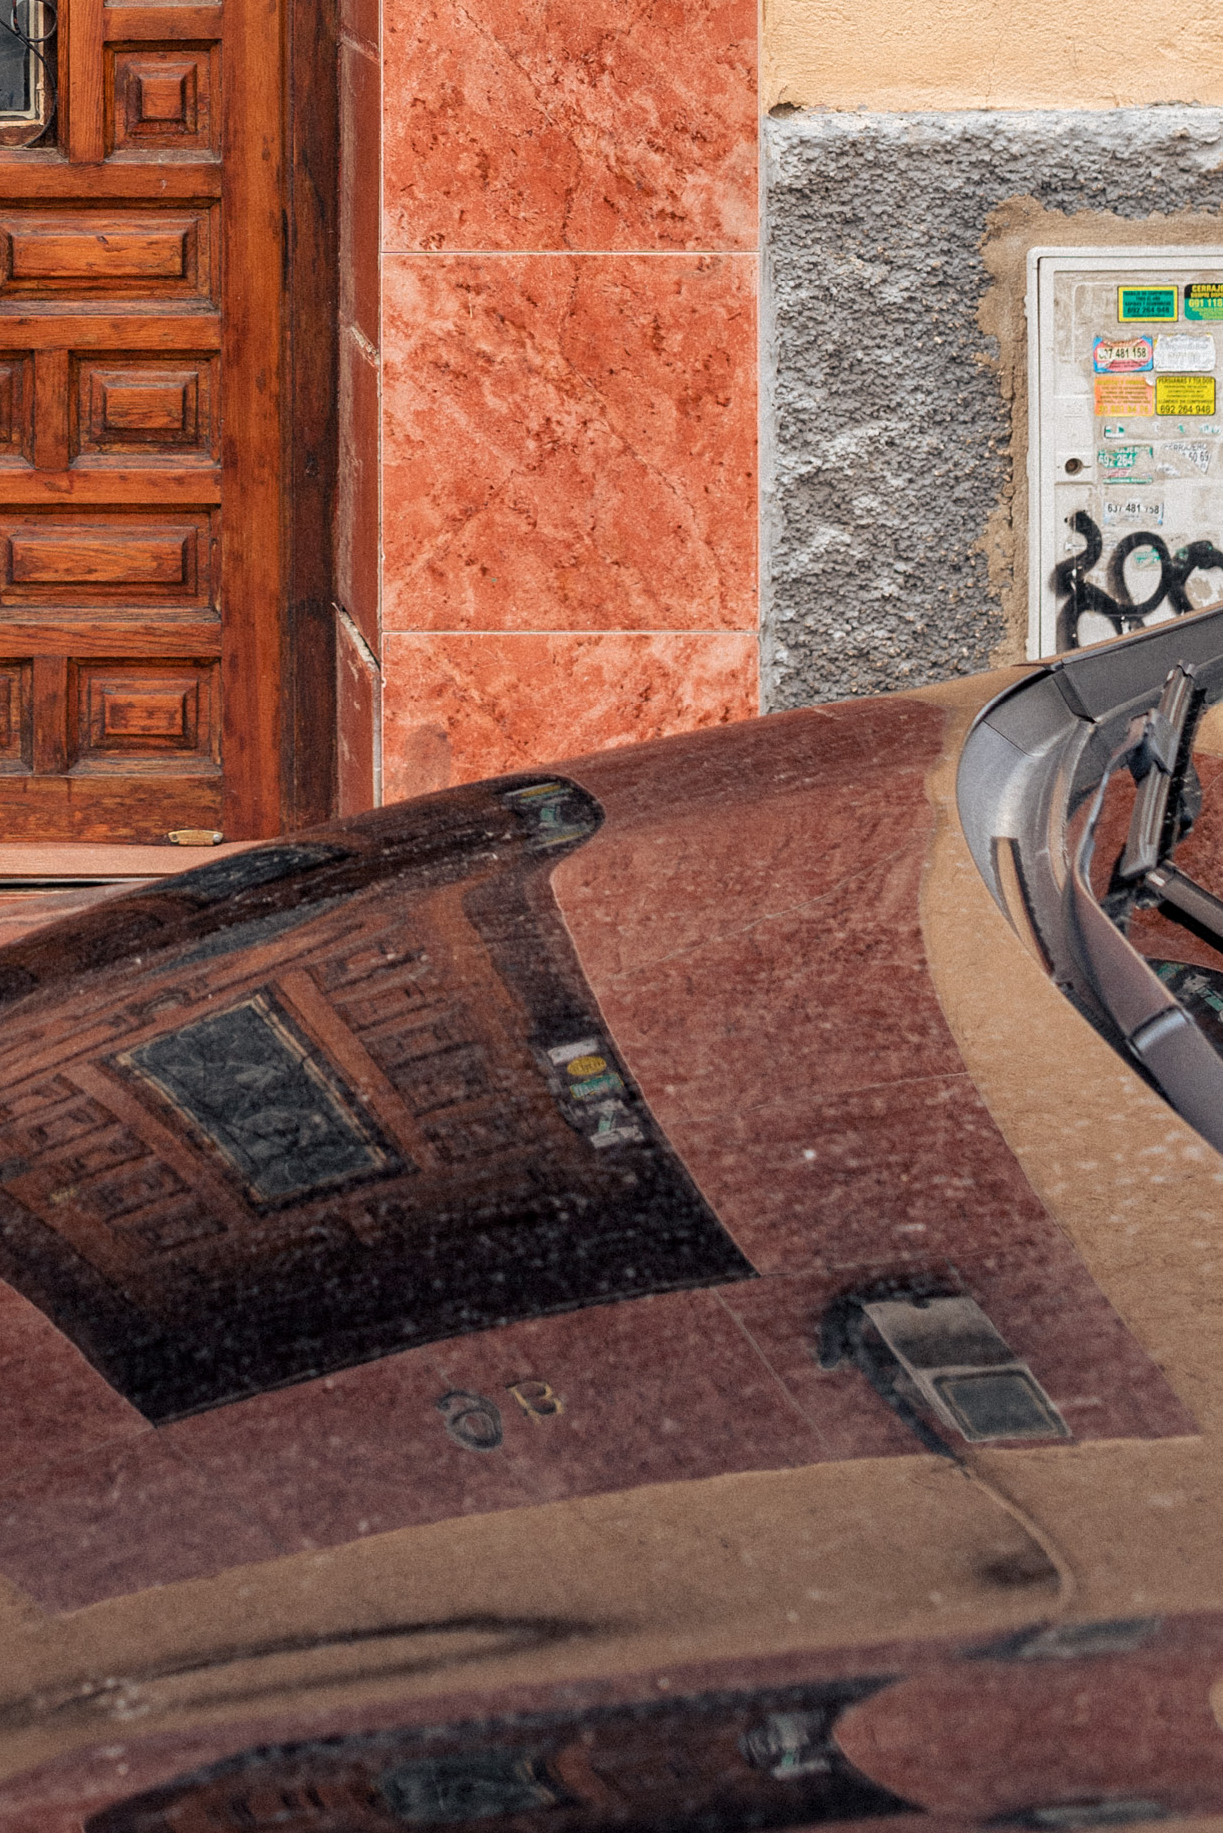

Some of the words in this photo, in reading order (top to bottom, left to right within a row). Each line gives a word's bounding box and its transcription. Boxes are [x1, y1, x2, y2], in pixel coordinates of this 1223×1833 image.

[1115, 347, 1129, 358] 481
[1132, 347, 1147, 358] 158
[1160, 405, 1175, 414] 692
[1178, 405, 1193, 414] 264
[1196, 405, 1211, 414] 948
[1125, 504, 1141, 513] 481
